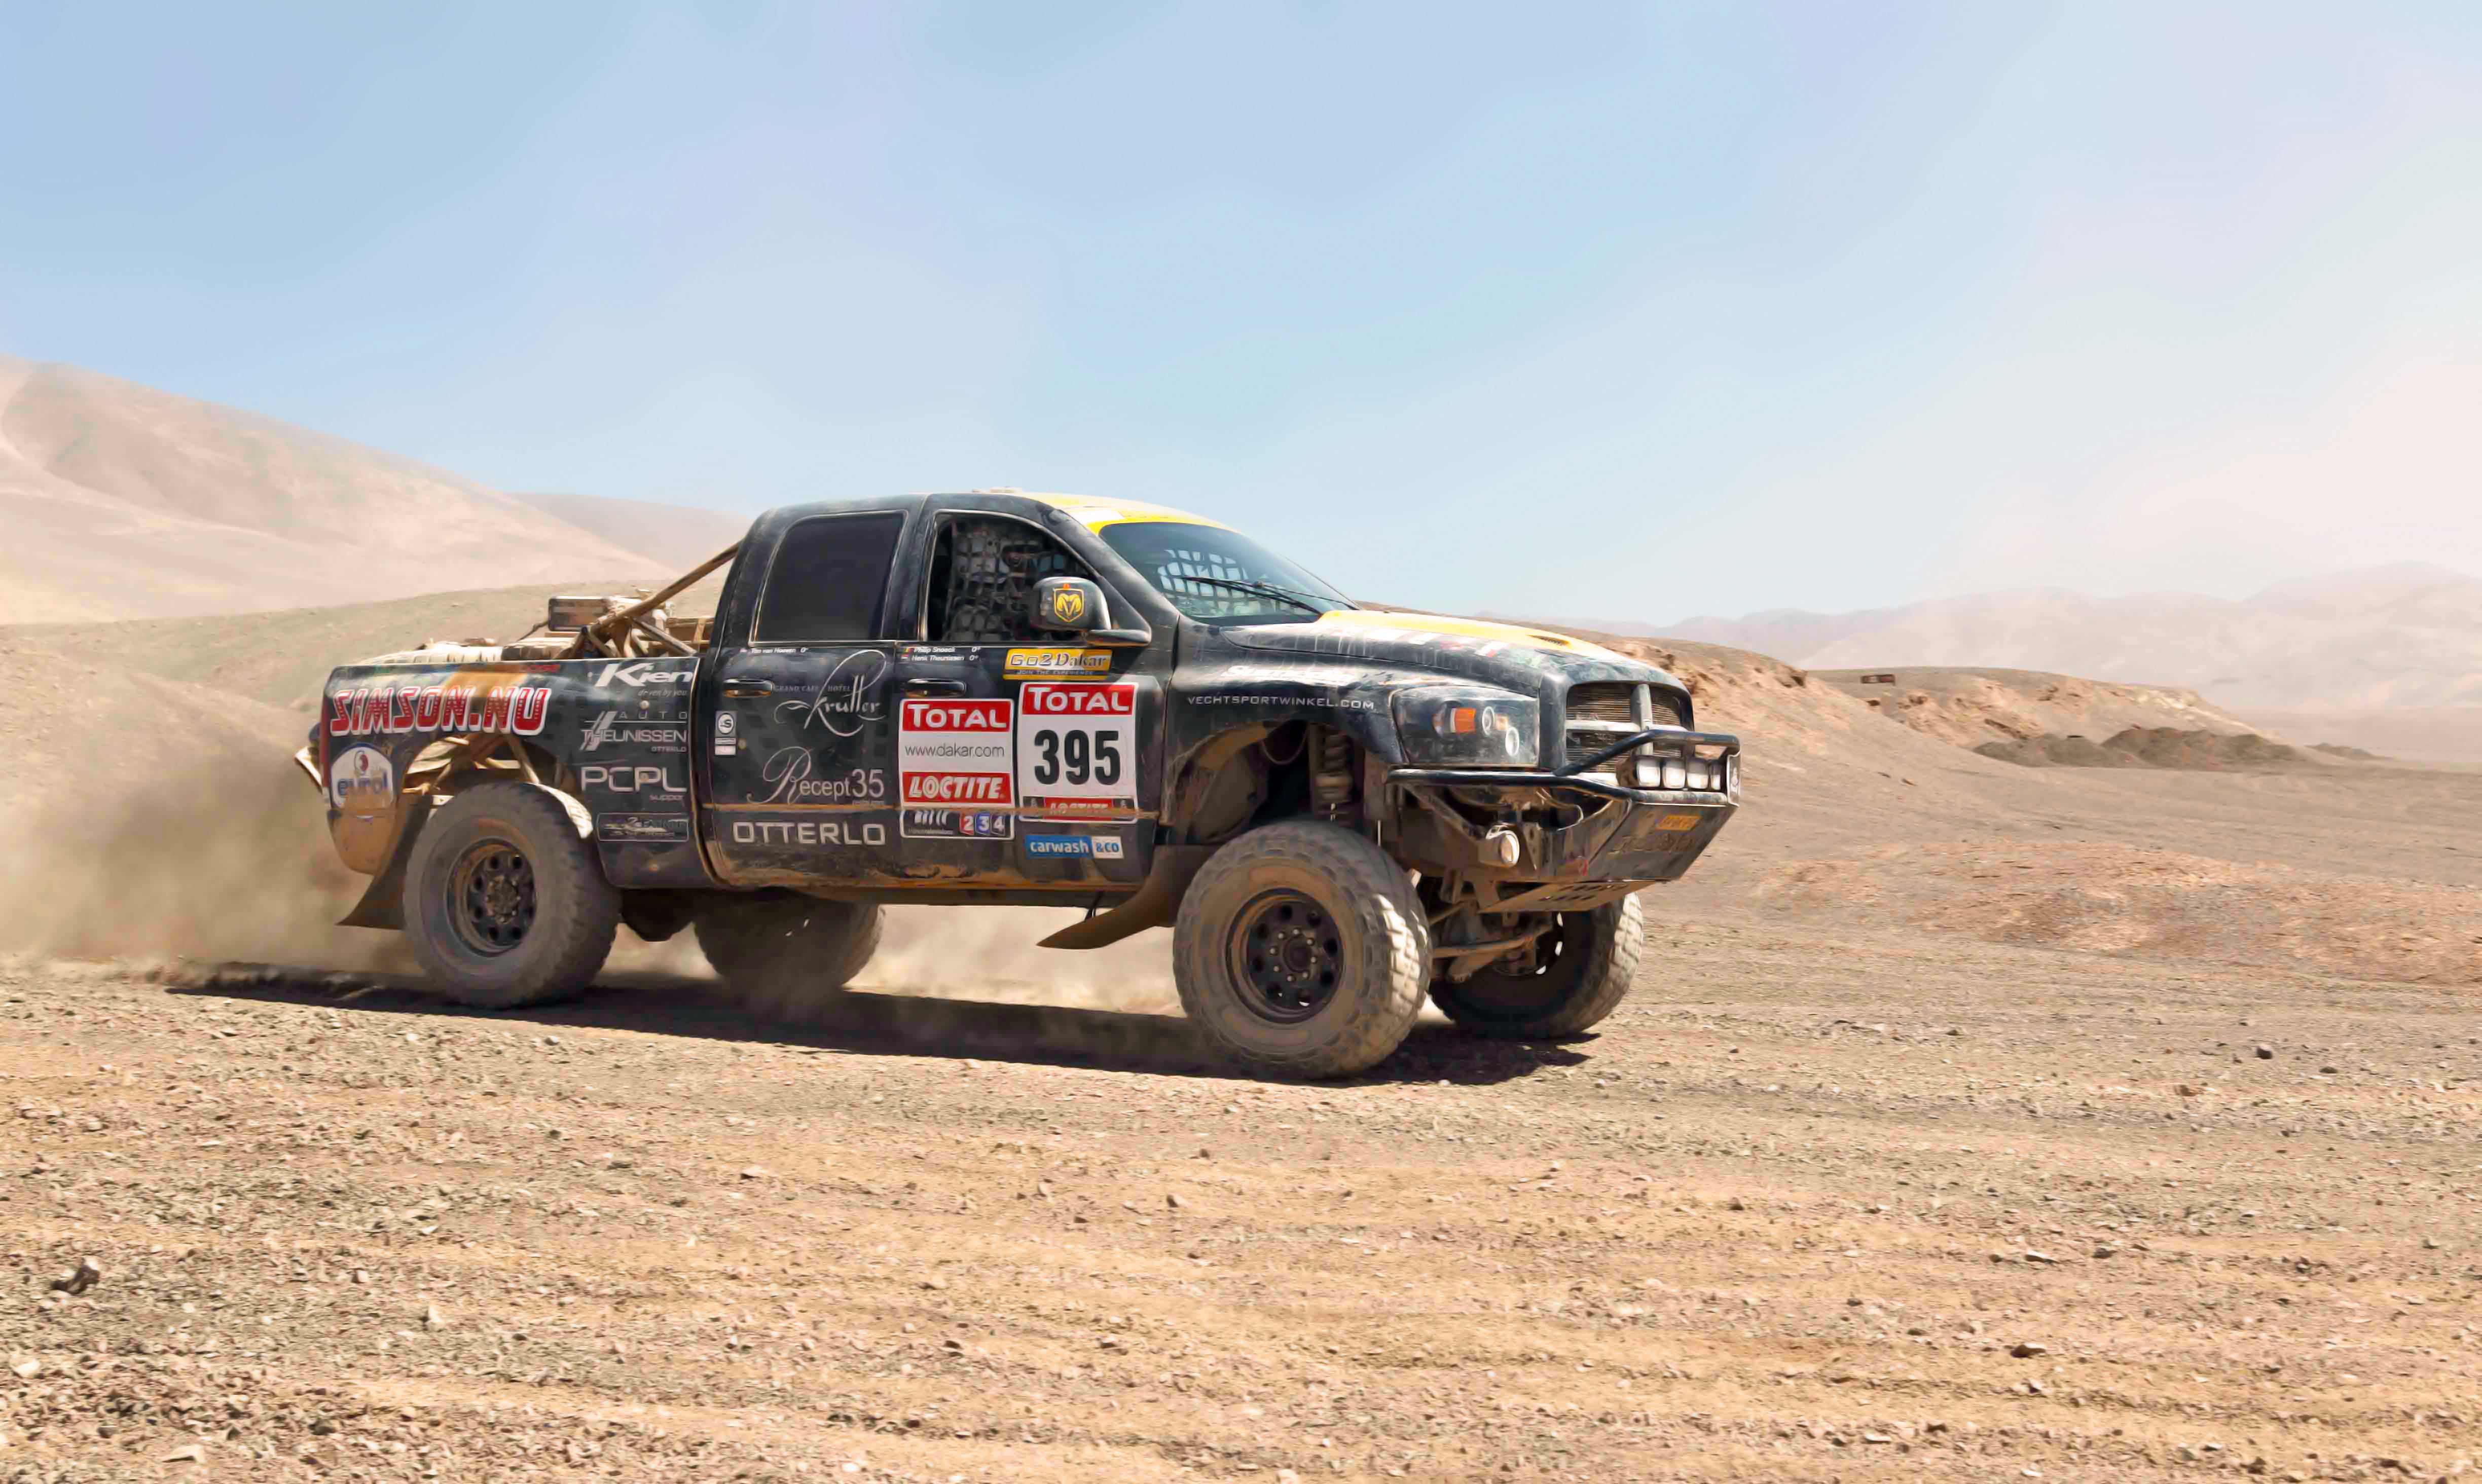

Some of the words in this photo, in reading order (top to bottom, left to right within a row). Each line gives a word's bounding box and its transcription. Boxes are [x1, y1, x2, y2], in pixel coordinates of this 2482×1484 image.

[331, 686, 552, 736] SIMSON.NU
[1028, 686, 1129, 712] TOTAL
[1188, 696, 1374, 710] VECHTSPORTWINKEL.COM
[906, 703, 1007, 728] TOTAL
[581, 729, 687, 743] THEUNISSEN
[905, 742, 1005, 758] www.dakar.com
[1034, 729, 1121, 786] 395
[581, 766, 687, 792] PCPL
[908, 775, 1005, 799] LOCTITE
[733, 820, 886, 845] OTTERLO
[993, 815, 1005, 832] 4
[1030, 839, 1089, 854] carwash
